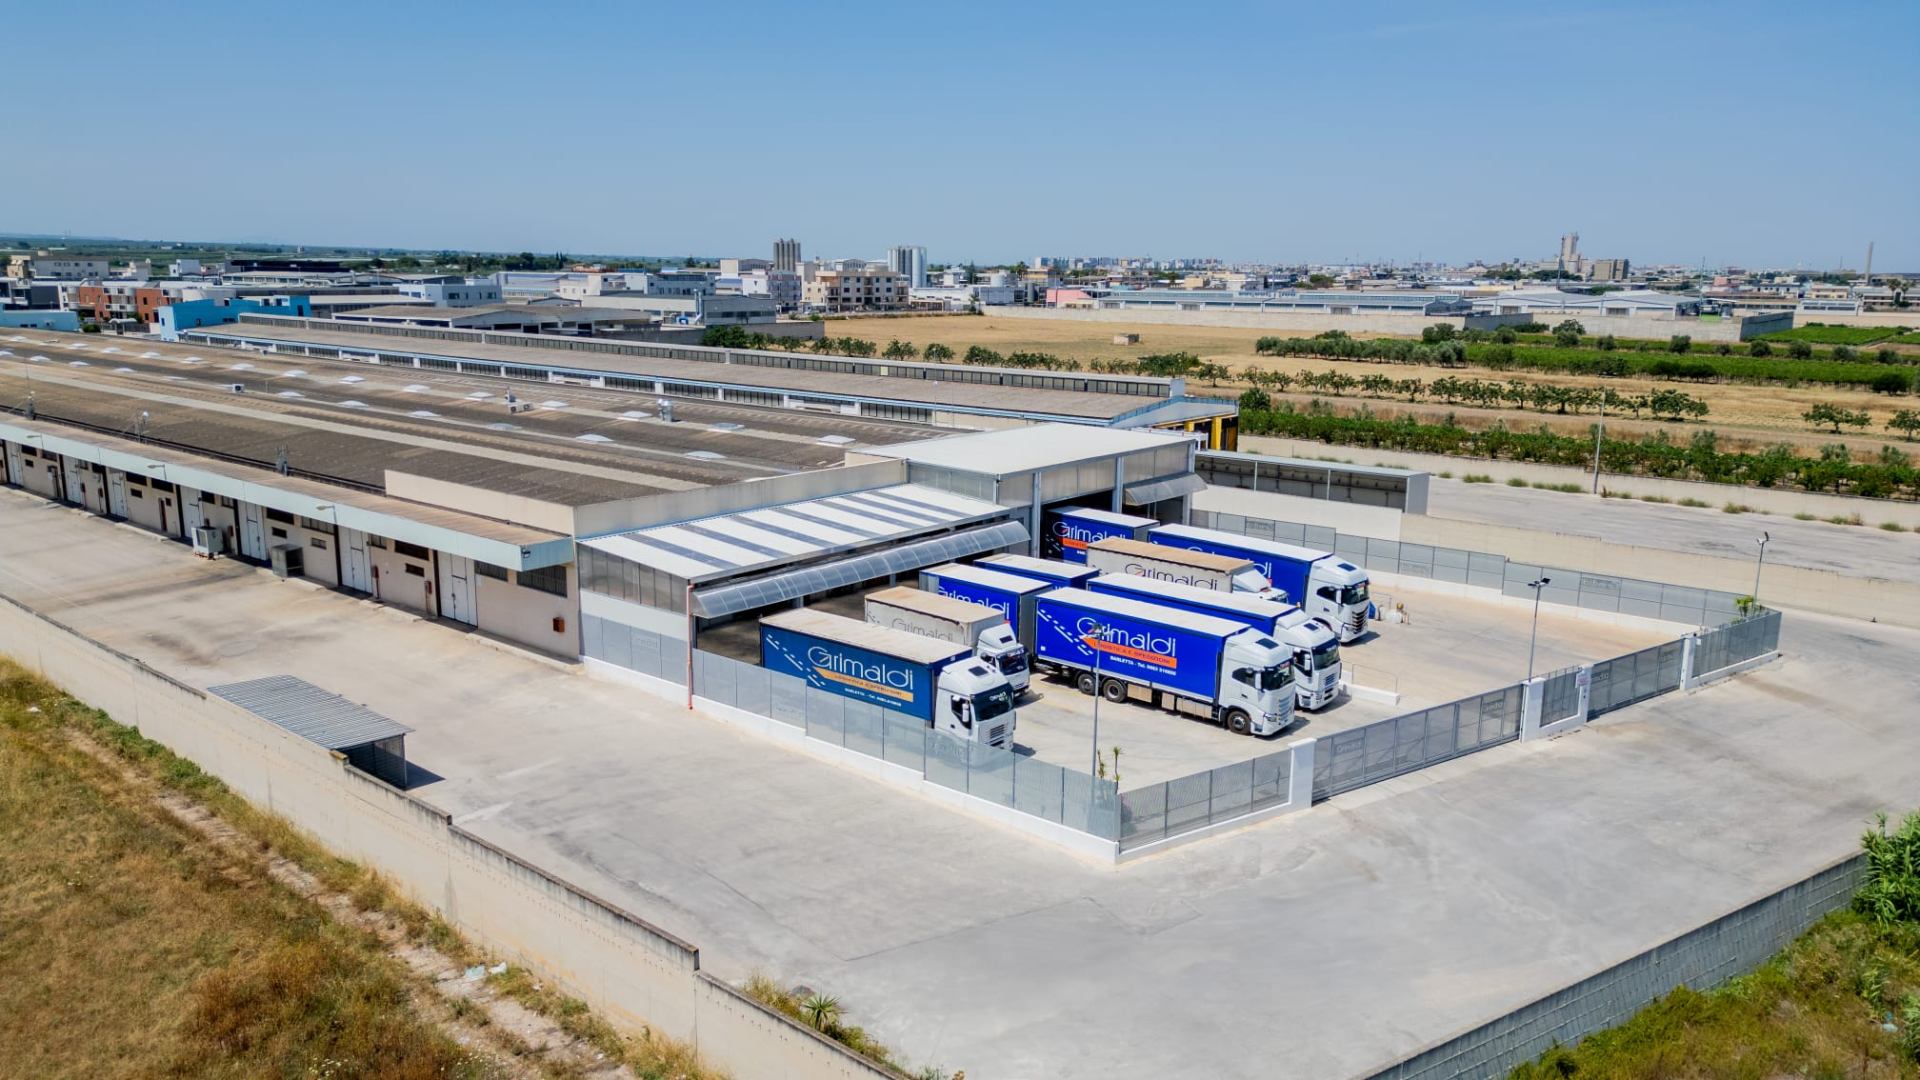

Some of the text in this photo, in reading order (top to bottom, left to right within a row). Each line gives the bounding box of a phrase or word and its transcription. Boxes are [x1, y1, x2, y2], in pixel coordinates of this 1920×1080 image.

[1052, 521, 1126, 543] Grima
[1076, 616, 1177, 657] Grimaldi
[807, 646, 914, 690] Grimaldi
